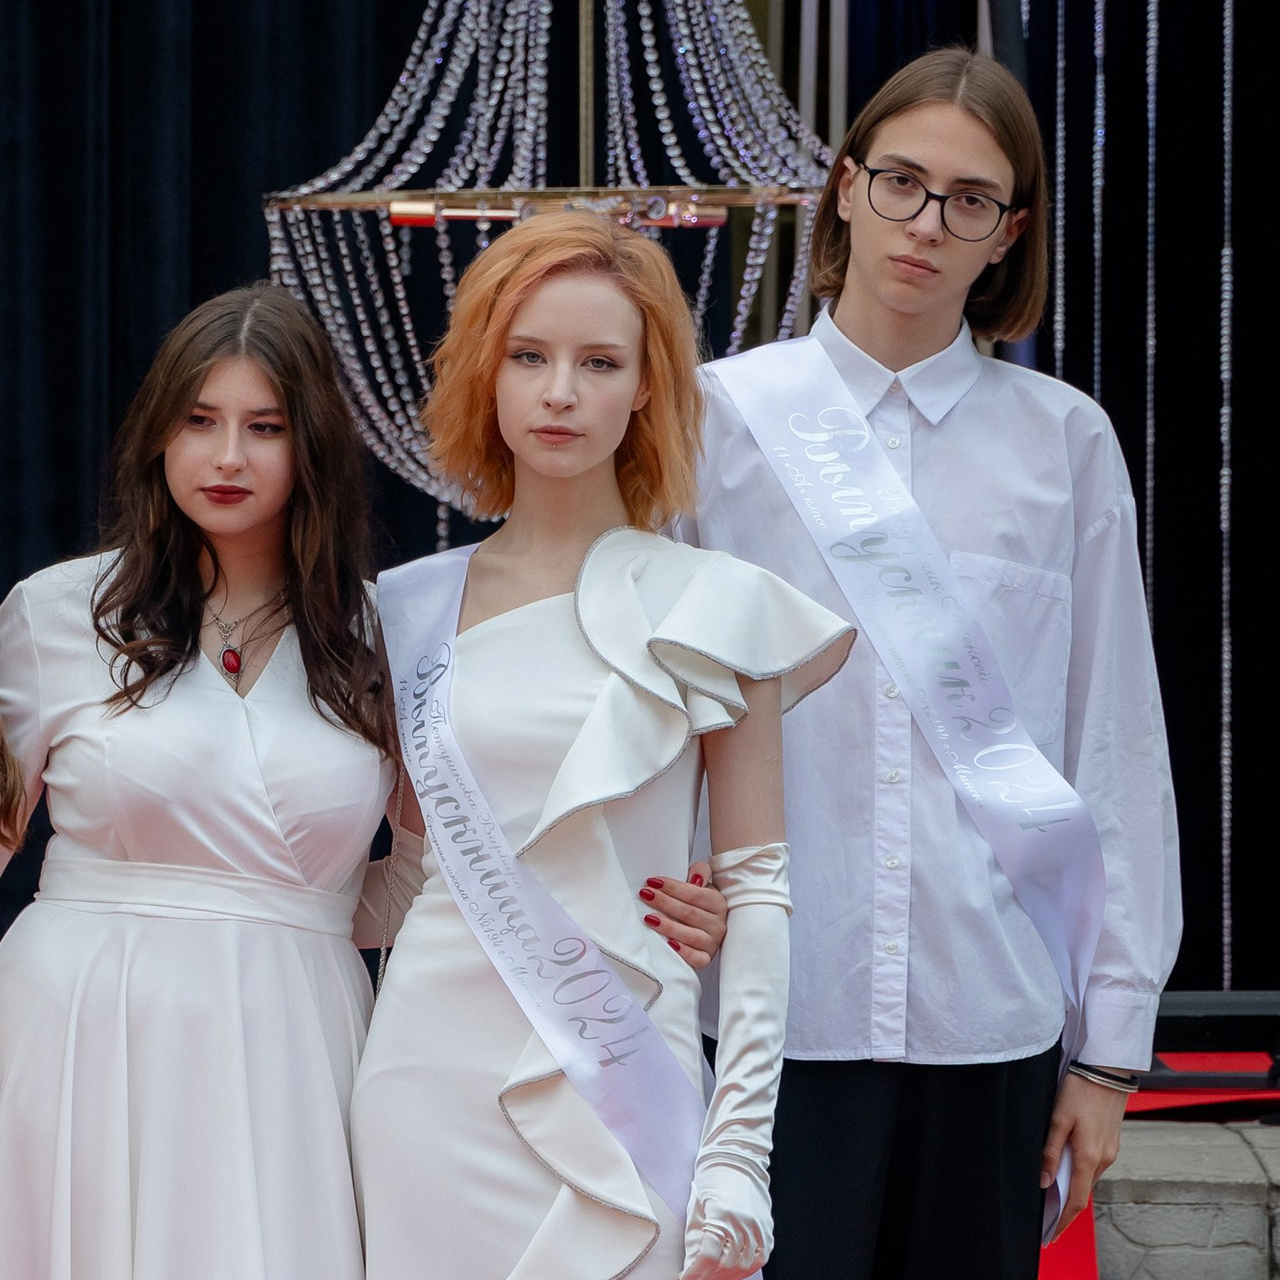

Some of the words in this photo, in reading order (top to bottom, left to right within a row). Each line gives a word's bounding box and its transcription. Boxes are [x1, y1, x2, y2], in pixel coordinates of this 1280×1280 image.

[773, 445, 791, 458] 11
[803, 496, 828, 530] класс
[429, 699, 477, 811] Петушкова
[476, 807, 523, 890] Варвара
[952, 707, 1081, 833] 2024
[411, 642, 542, 952] Выпускница
[527, 937, 652, 1068] 2024
[445, 865, 470, 903] школа
[469, 901, 505, 949] №194
